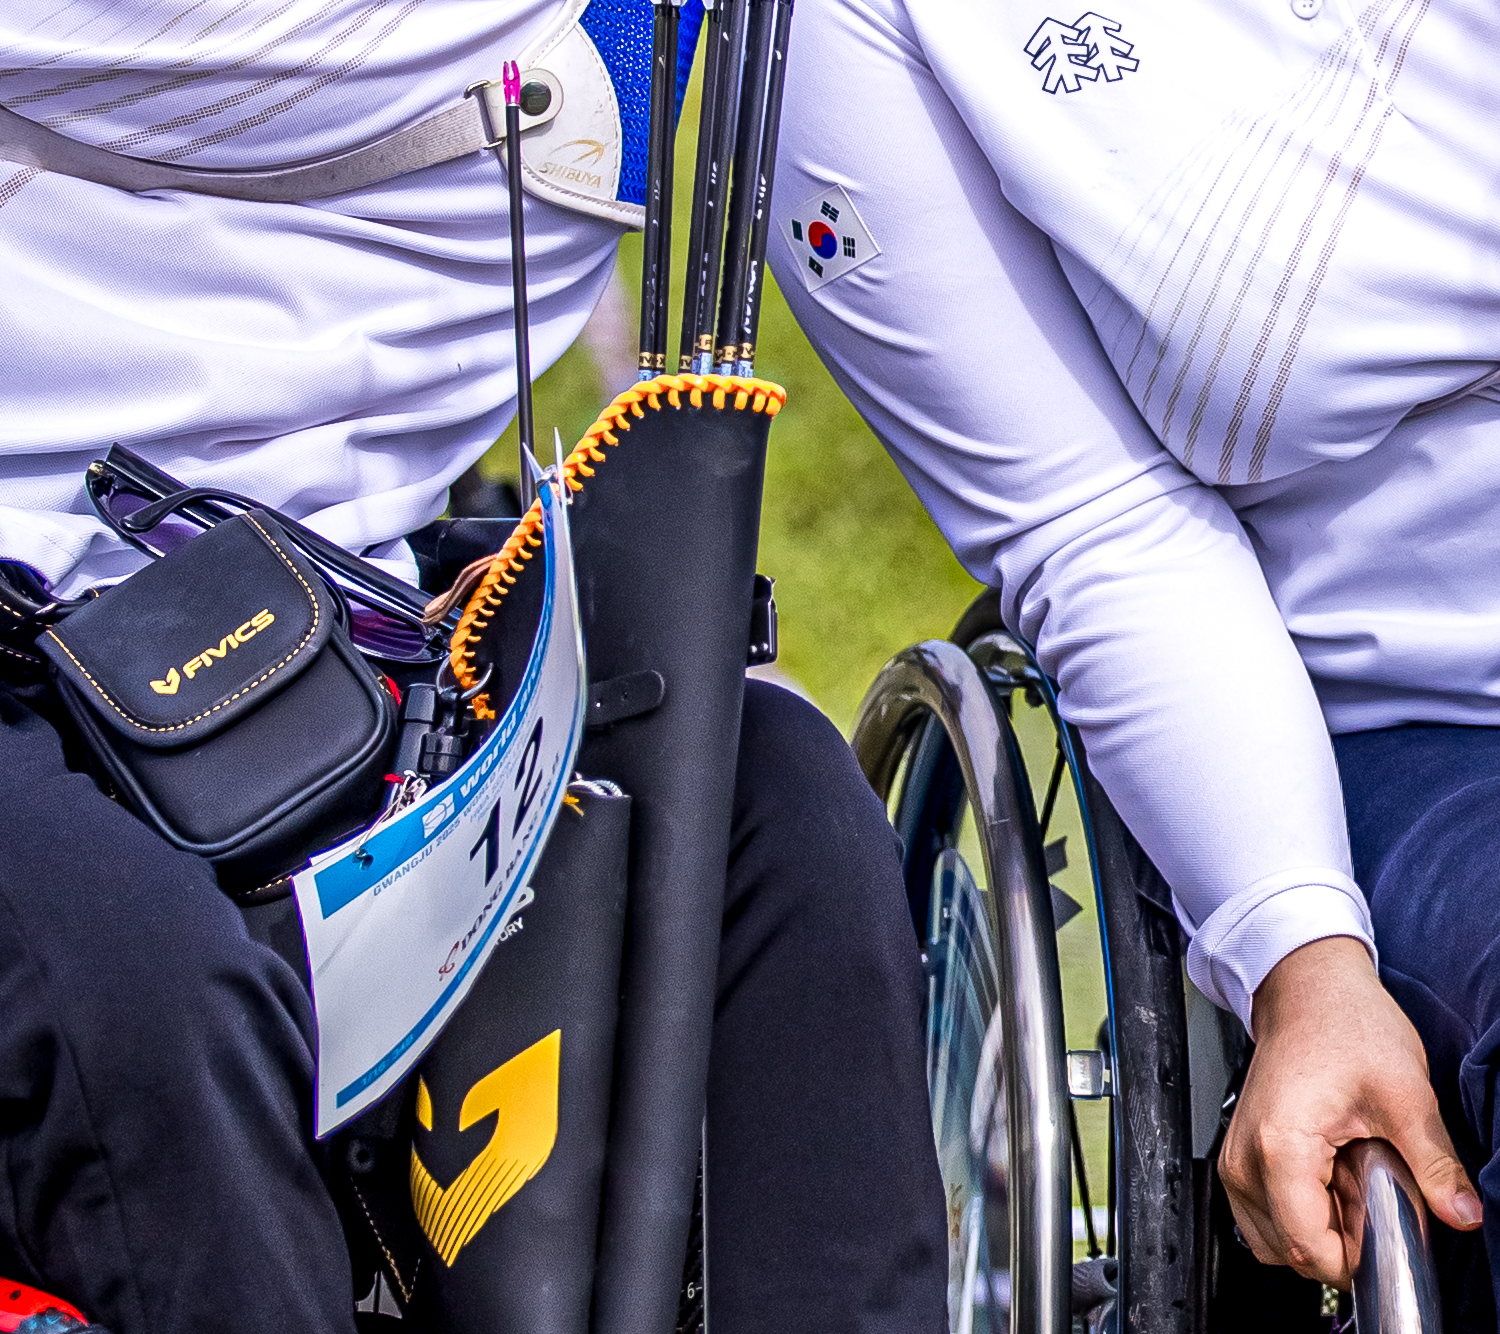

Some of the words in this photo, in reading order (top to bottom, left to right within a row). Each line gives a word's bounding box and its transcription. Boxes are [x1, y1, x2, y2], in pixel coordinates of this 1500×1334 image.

[539, 161, 602, 189] SHIBUYA
[182, 608, 275, 680] FIVICS
[469, 716, 544, 889] 12
[373, 847, 434, 896] GWANGJU
[436, 819, 462, 854] 2025
